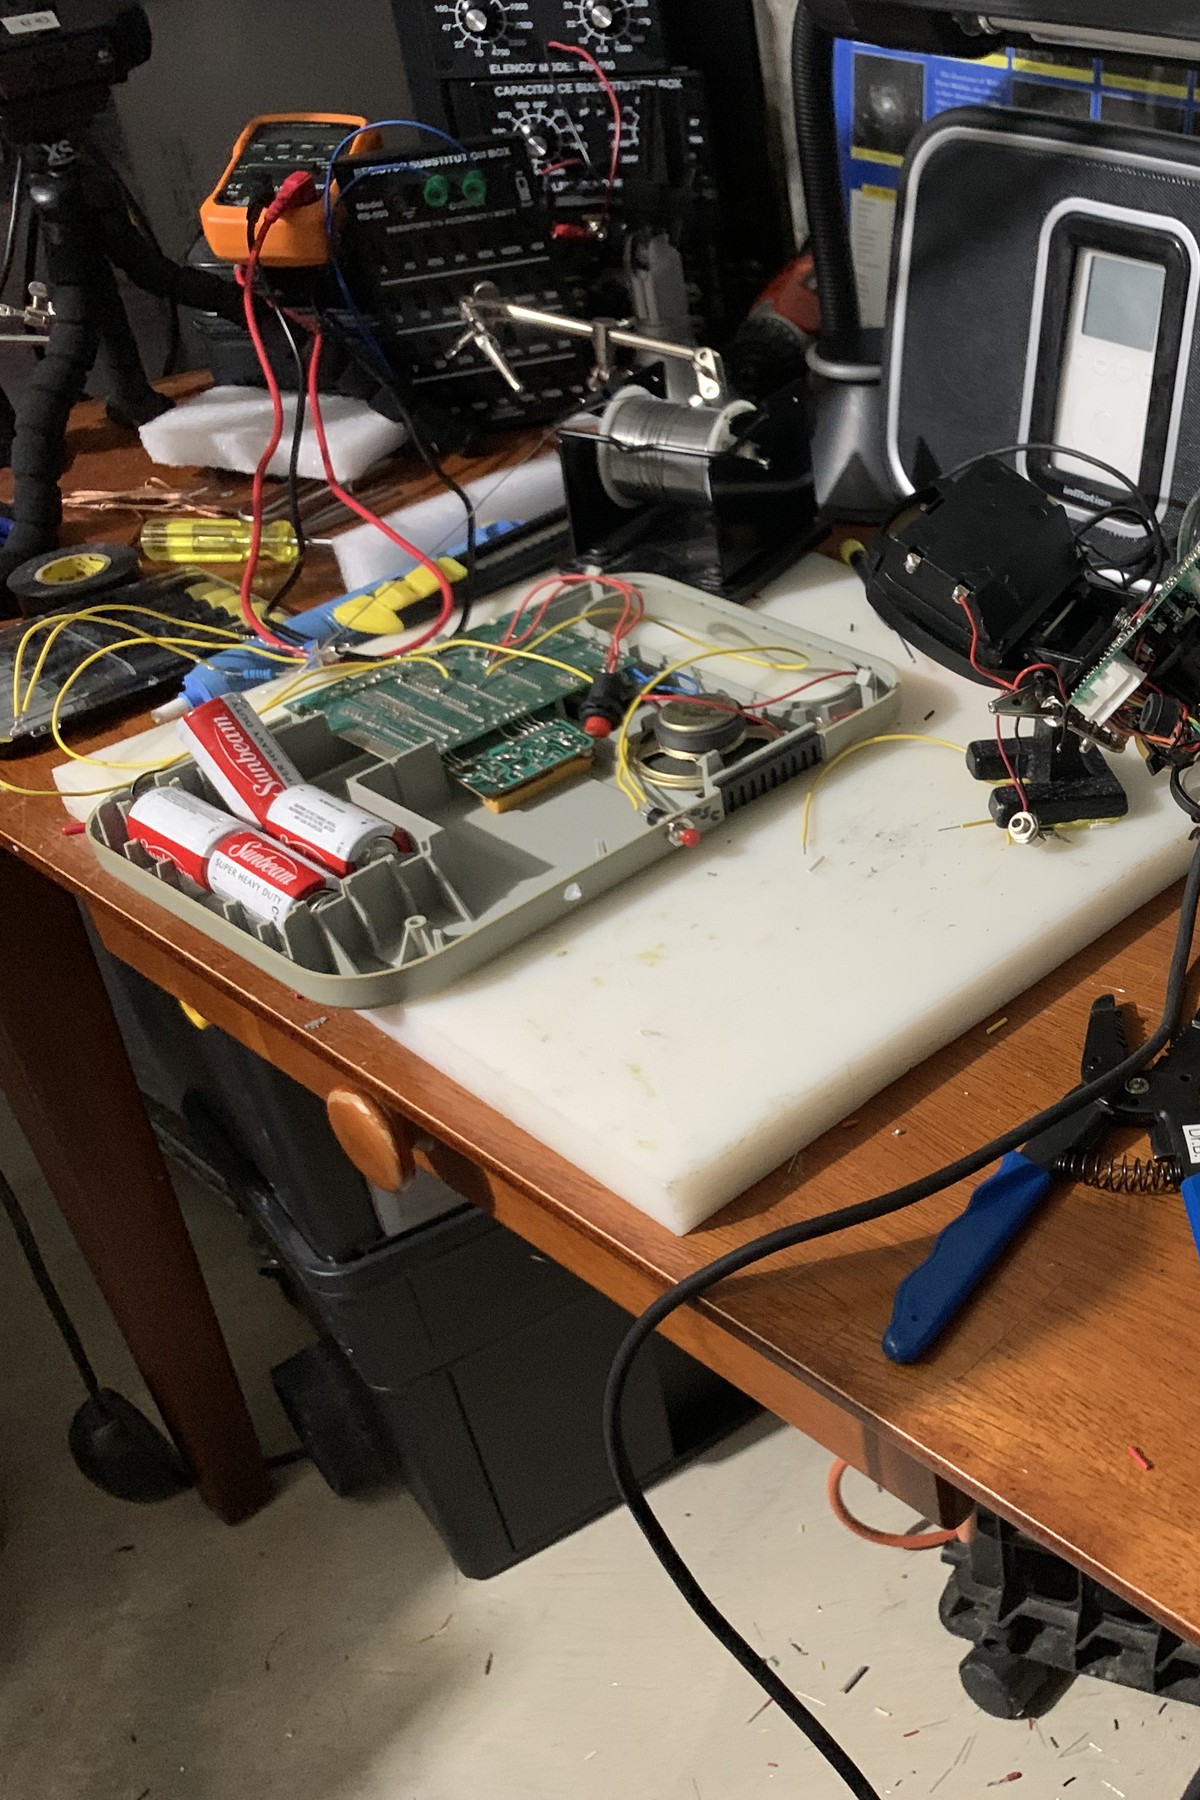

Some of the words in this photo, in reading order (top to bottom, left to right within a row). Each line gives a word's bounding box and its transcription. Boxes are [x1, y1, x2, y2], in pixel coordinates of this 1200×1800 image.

[212, 714, 280, 797] Sunbeam
[215, 857, 238, 877] SUPER
[238, 872, 261, 893] HEAVY
[261, 888, 284, 906] DUTY
[229, 840, 298, 885] Sunbeam
